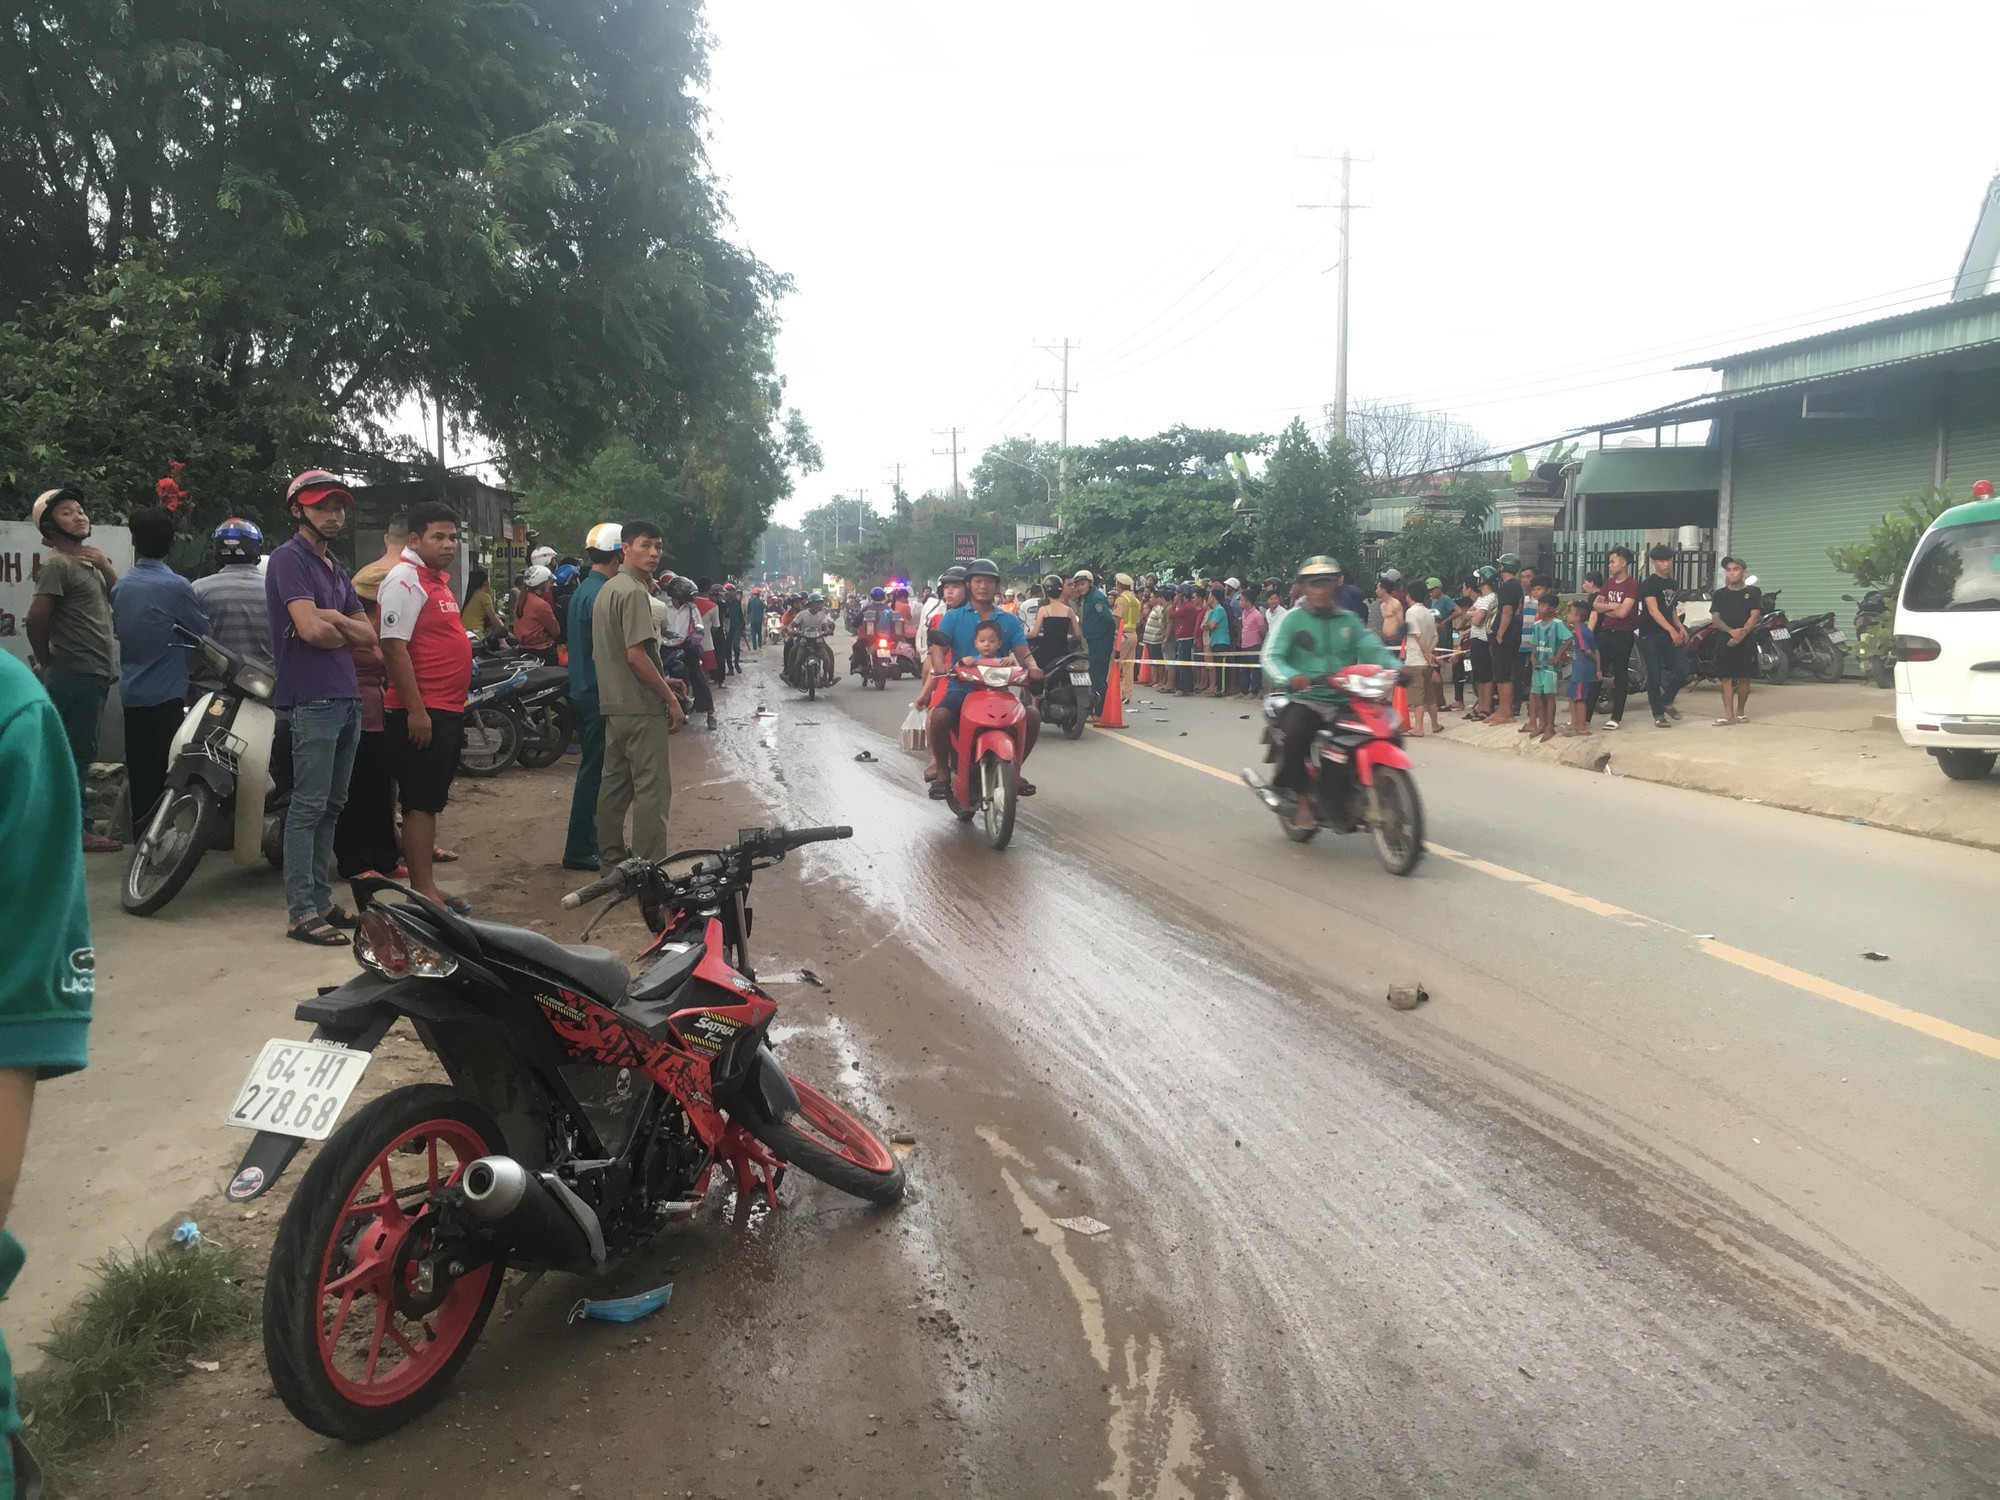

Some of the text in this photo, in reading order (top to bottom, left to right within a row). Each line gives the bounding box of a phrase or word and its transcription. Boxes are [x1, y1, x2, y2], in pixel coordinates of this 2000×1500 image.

[693, 1017, 736, 1037] SATRIA
[312, 1038, 348, 1049] SUZUKI
[266, 1048, 349, 1090] 64-H1
[234, 1084, 338, 1132] 278.68
